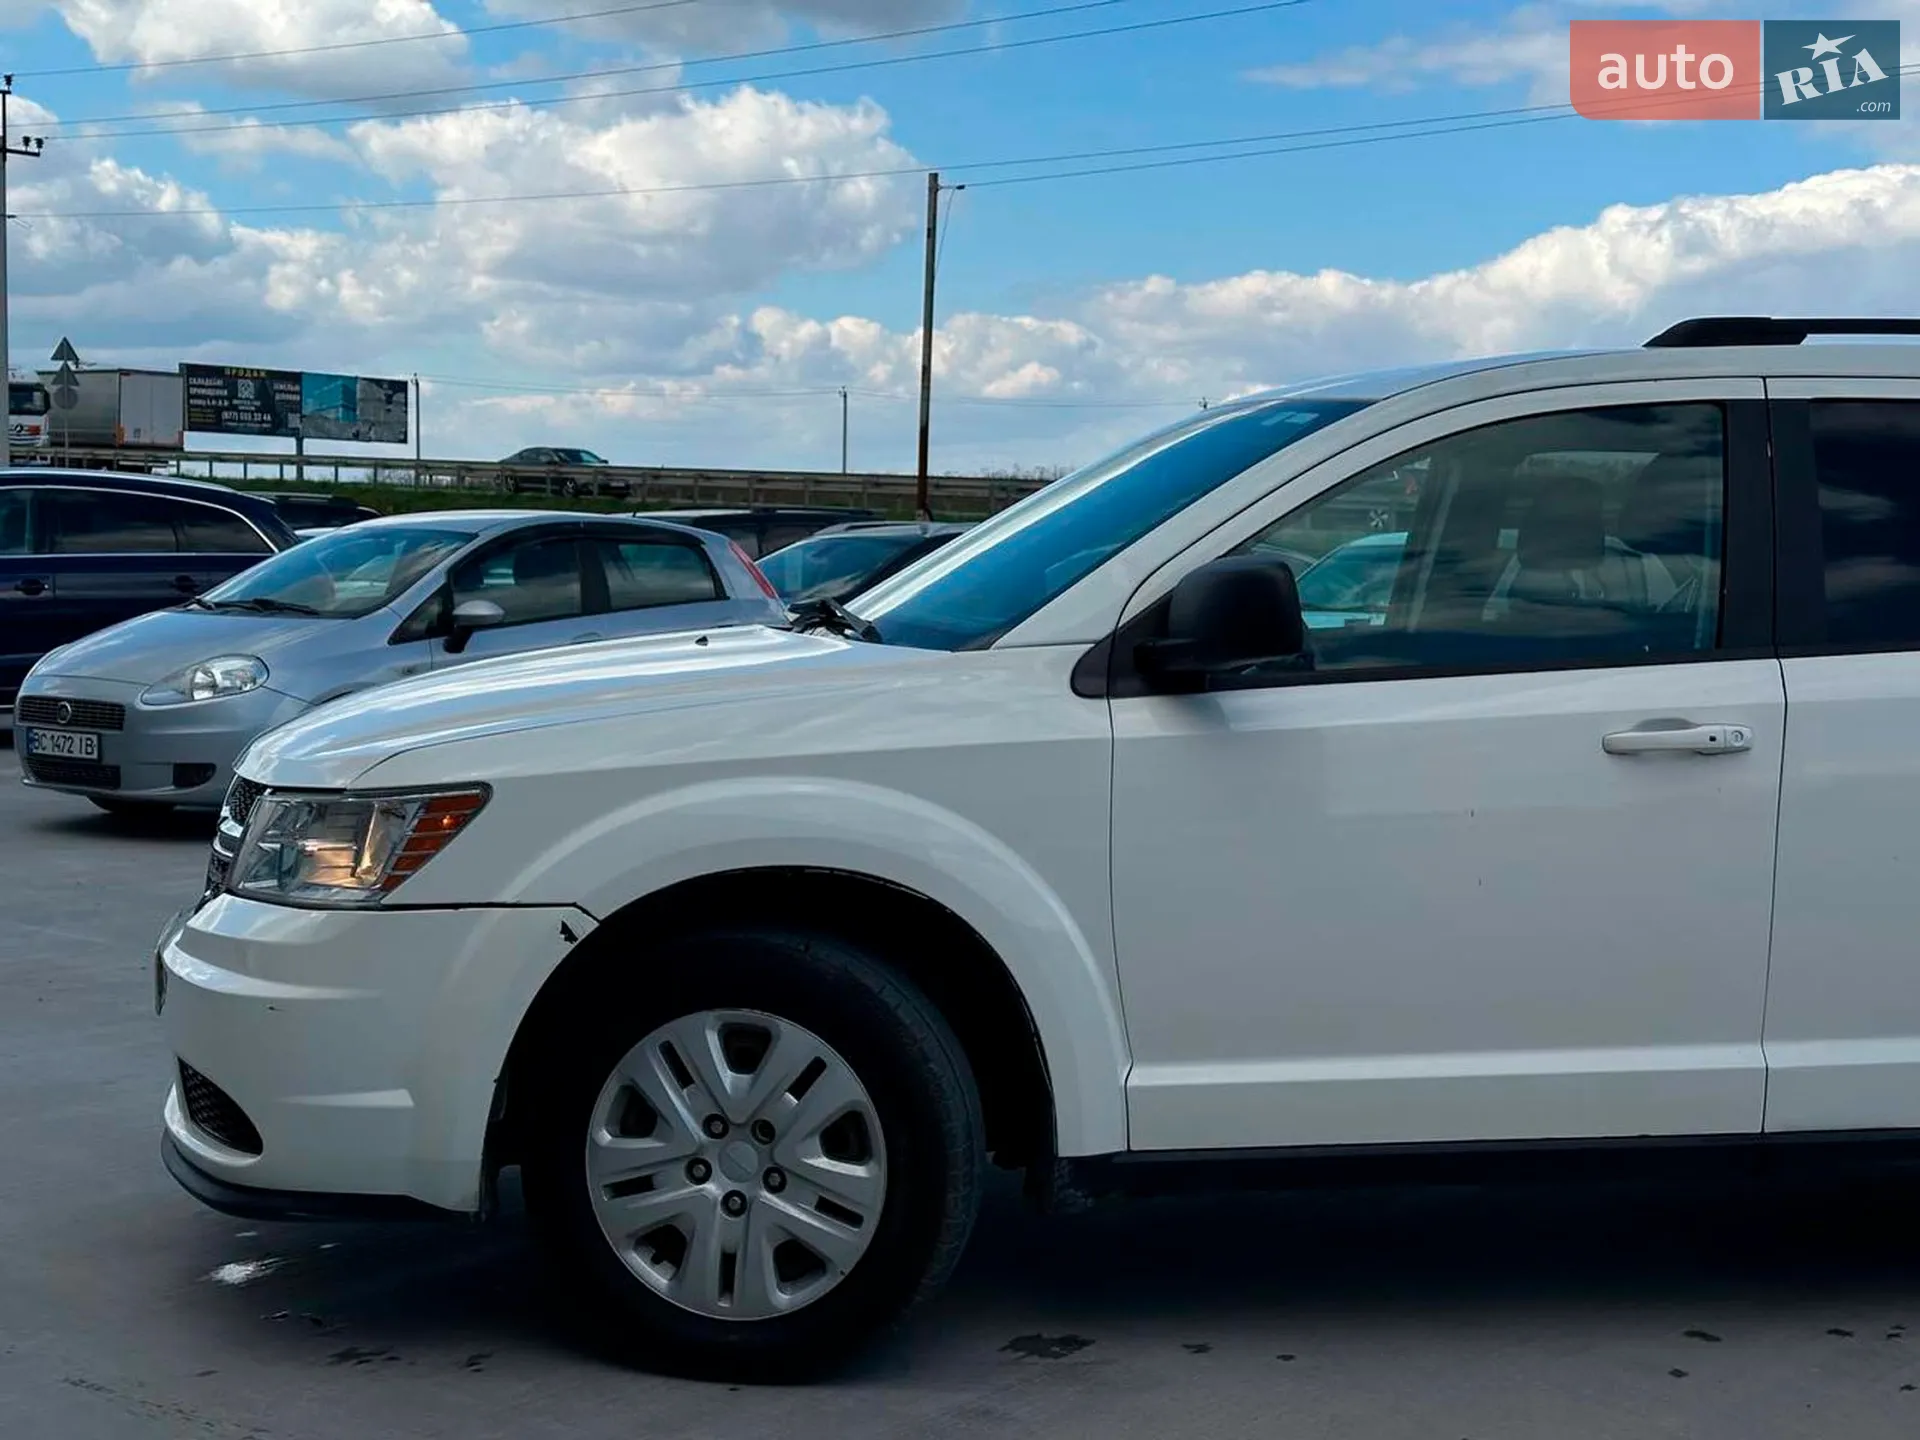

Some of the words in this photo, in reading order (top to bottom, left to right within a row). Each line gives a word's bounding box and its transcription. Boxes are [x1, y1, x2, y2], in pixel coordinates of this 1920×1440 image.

[33, 732, 48, 751] BC
[50, 734, 74, 754] 1472
[78, 736, 94, 755] IB
